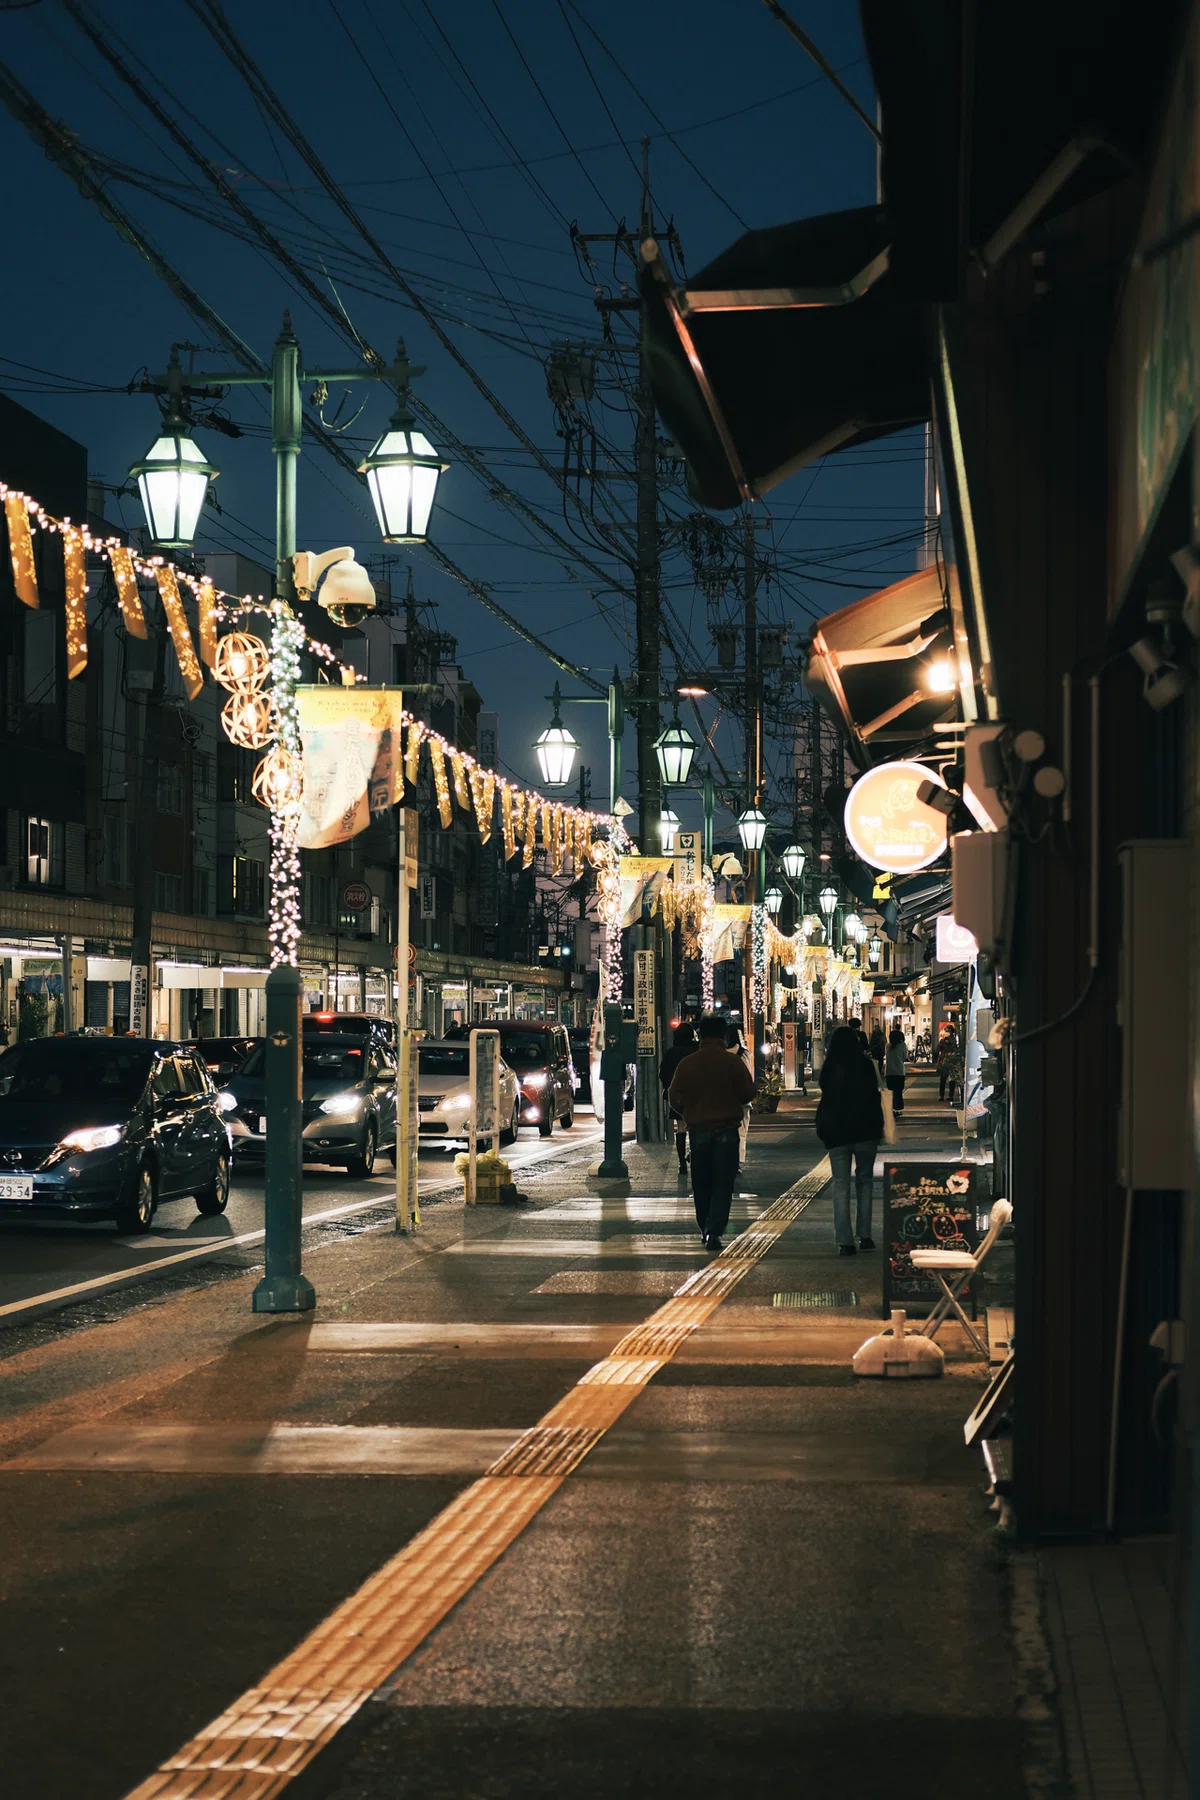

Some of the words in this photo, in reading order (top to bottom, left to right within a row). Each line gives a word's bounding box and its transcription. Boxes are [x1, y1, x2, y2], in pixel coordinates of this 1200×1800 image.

[637, 952, 648, 1035] 西村行政書士事務所
